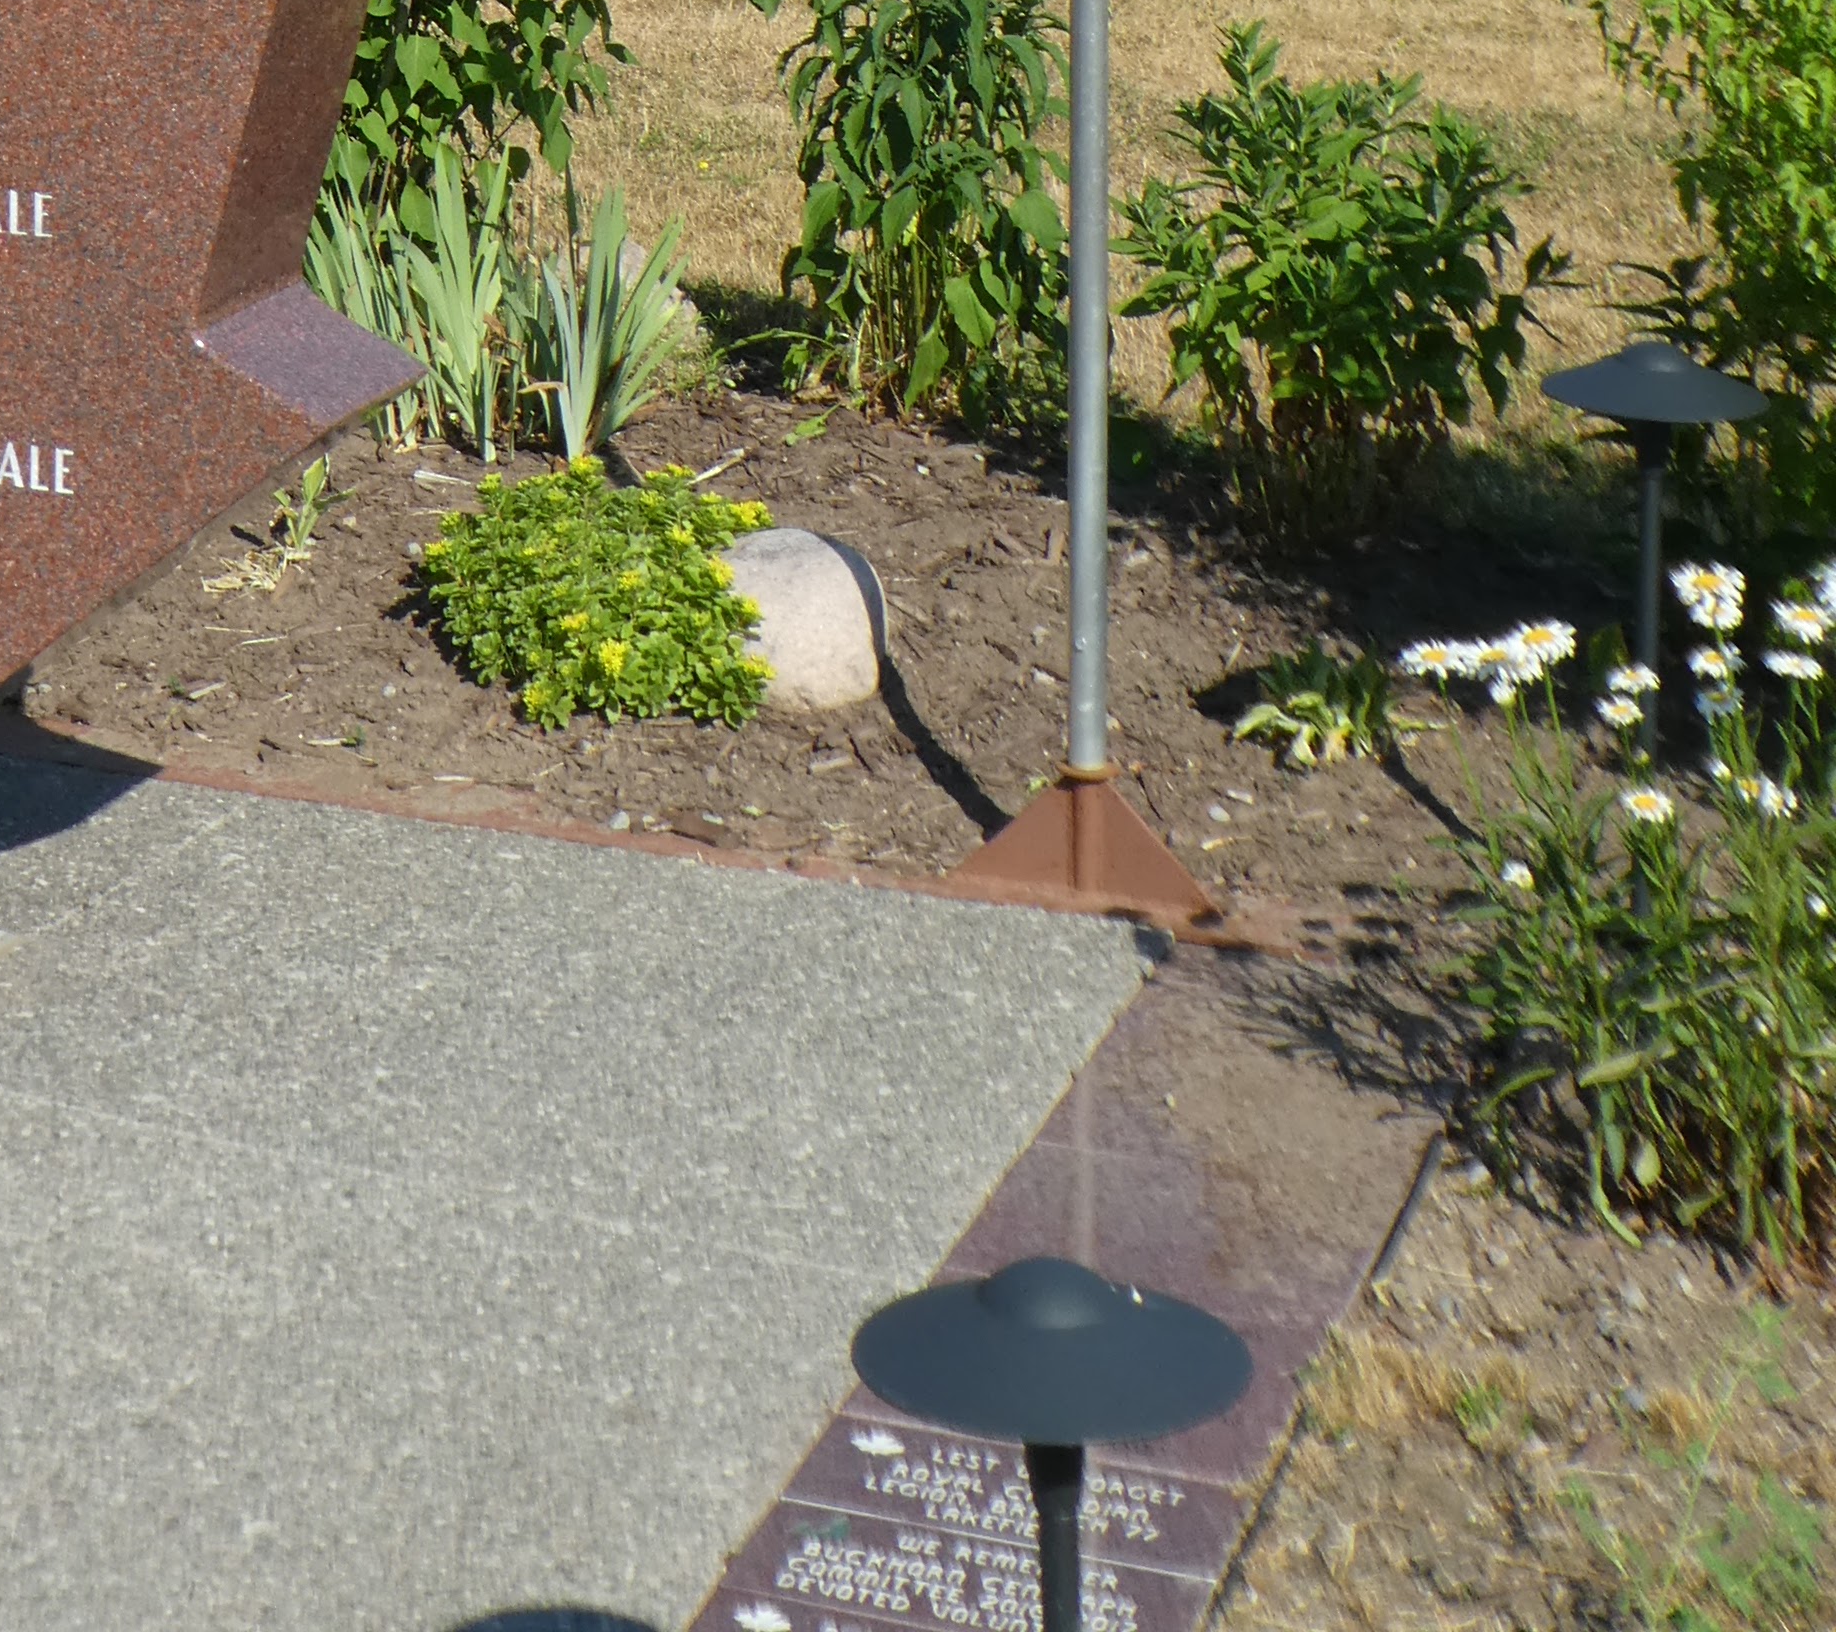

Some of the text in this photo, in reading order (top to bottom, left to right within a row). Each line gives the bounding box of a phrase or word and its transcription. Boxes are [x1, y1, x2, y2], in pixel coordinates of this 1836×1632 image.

[932, 1446, 1001, 1473] LEST
[1086, 1476, 1186, 1508] ORGET
[926, 1502, 1041, 1539] LAKEFIE
[897, 1534, 941, 1557] WE
[775, 1570, 912, 1613] DEVOTED
[787, 1555, 966, 1605] COMMITTEE
